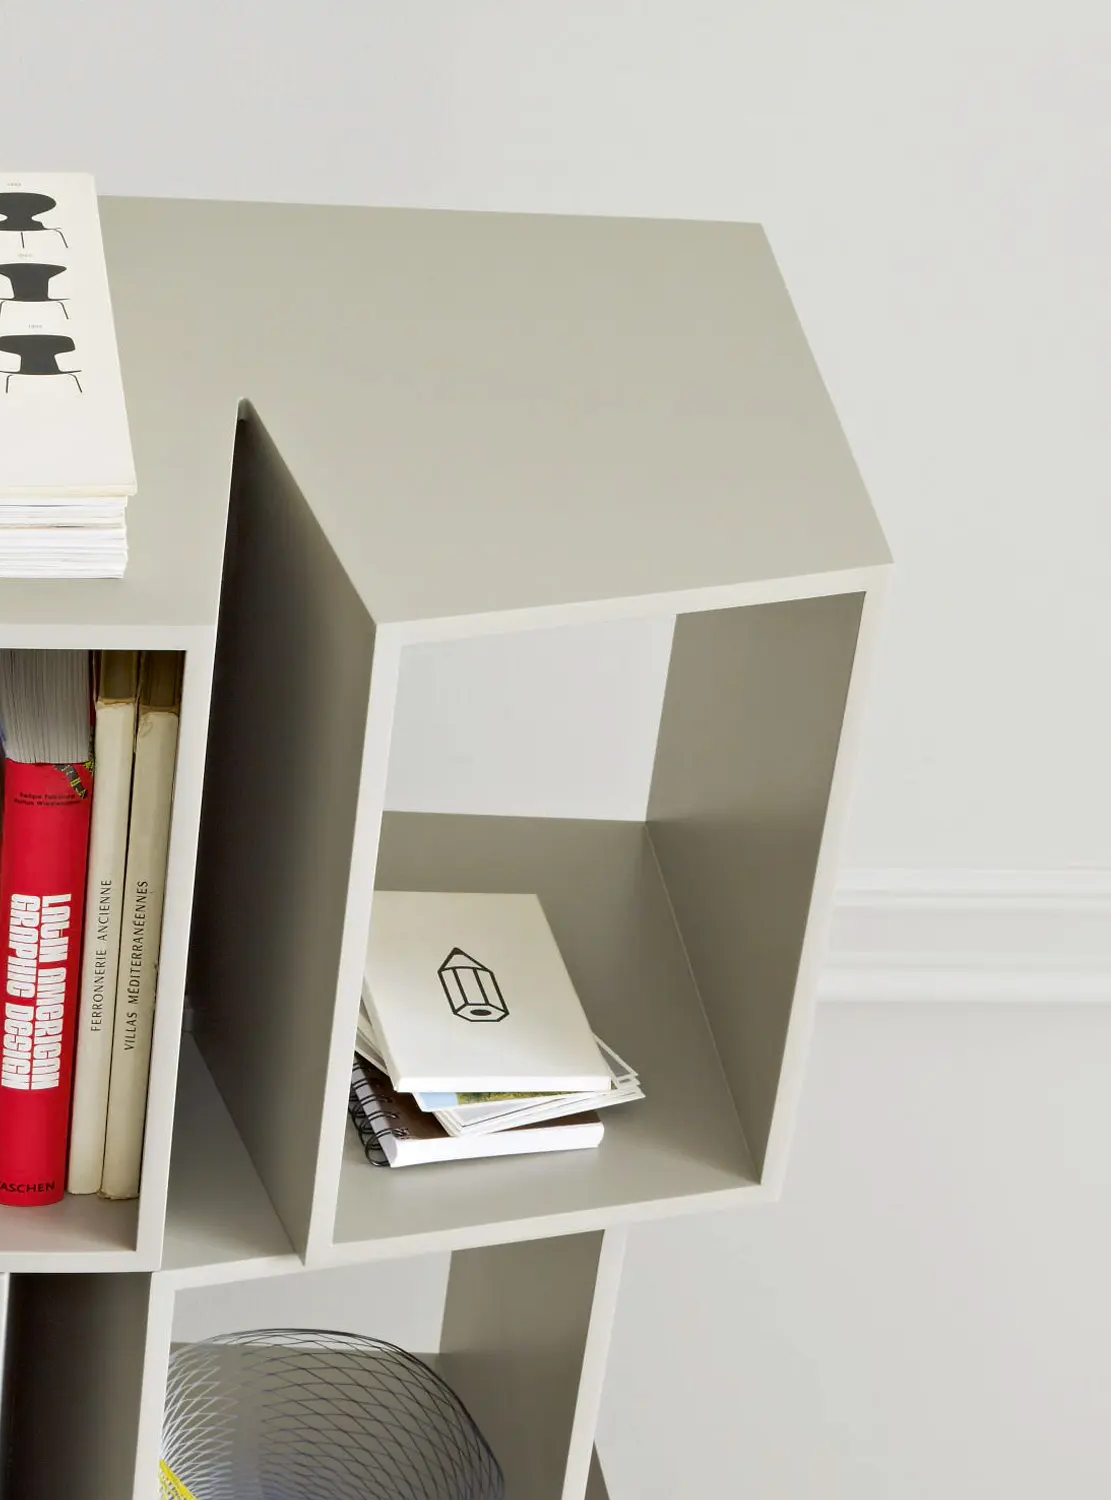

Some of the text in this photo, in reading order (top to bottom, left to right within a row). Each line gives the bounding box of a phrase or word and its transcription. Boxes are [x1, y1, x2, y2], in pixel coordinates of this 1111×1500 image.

[90, 879, 113, 1032] FERRONNERIE ANCIENNE
[124, 880, 149, 1051] VILLAS MÉDITERRANÉENNES
